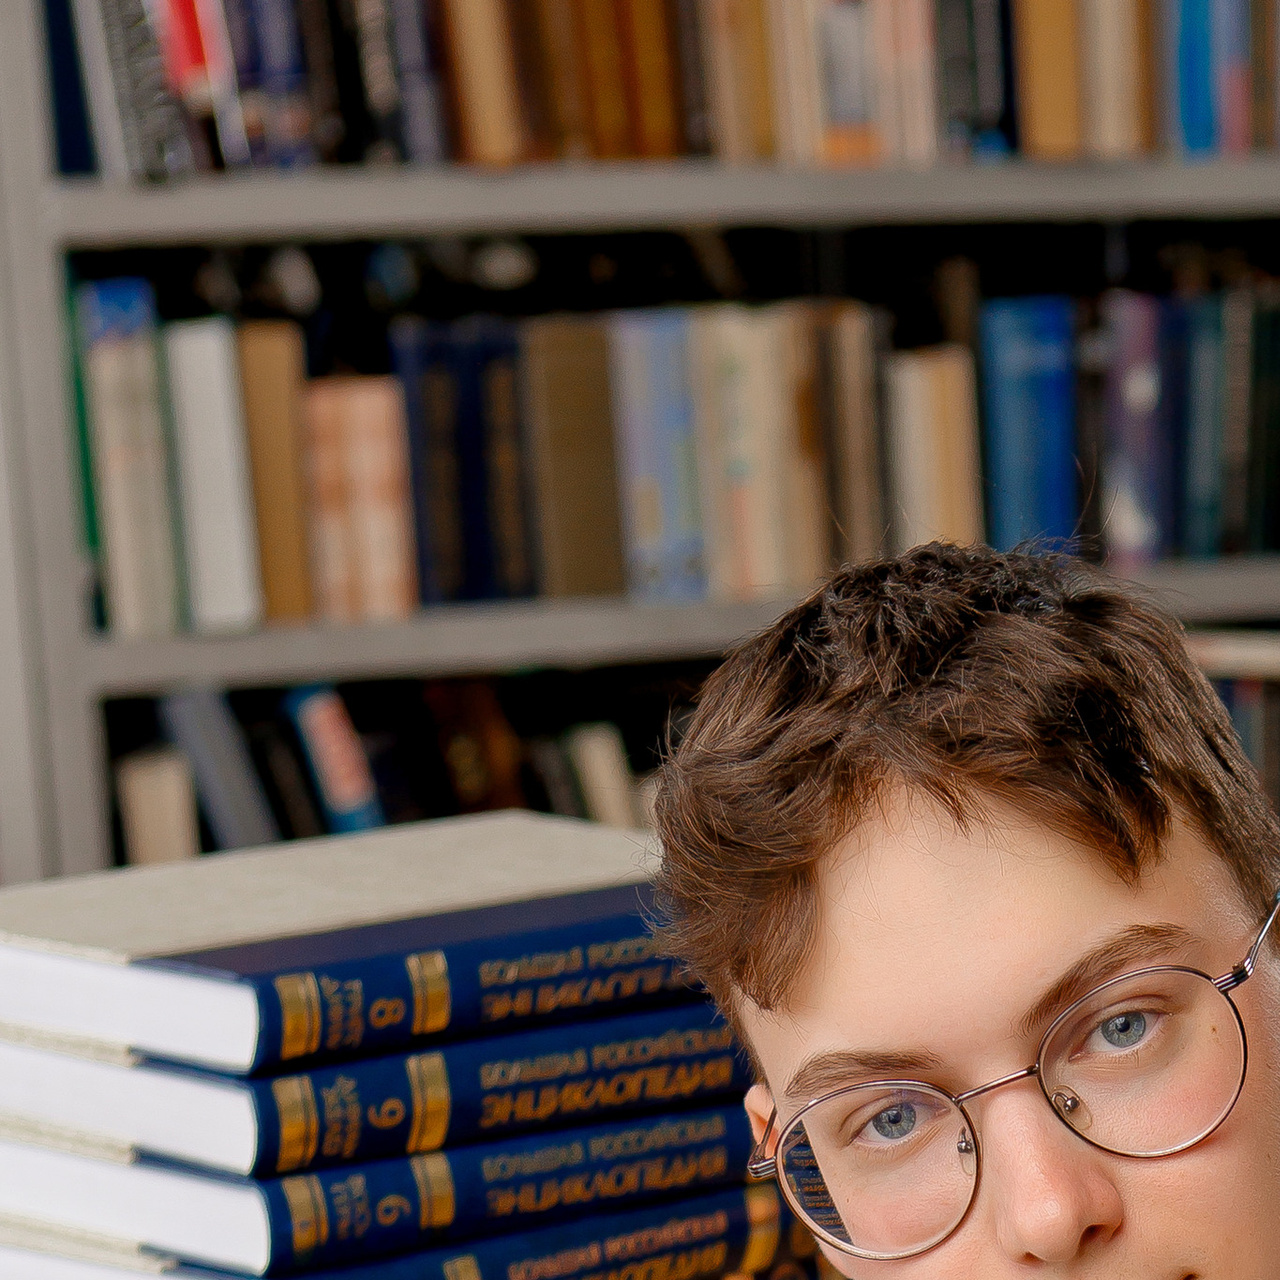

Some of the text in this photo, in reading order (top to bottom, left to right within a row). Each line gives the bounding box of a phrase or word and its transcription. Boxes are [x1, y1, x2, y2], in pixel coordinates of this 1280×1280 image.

[368, 997, 407, 1031] 8
[367, 1097, 407, 1130] 9
[375, 1194, 412, 1227] 6
